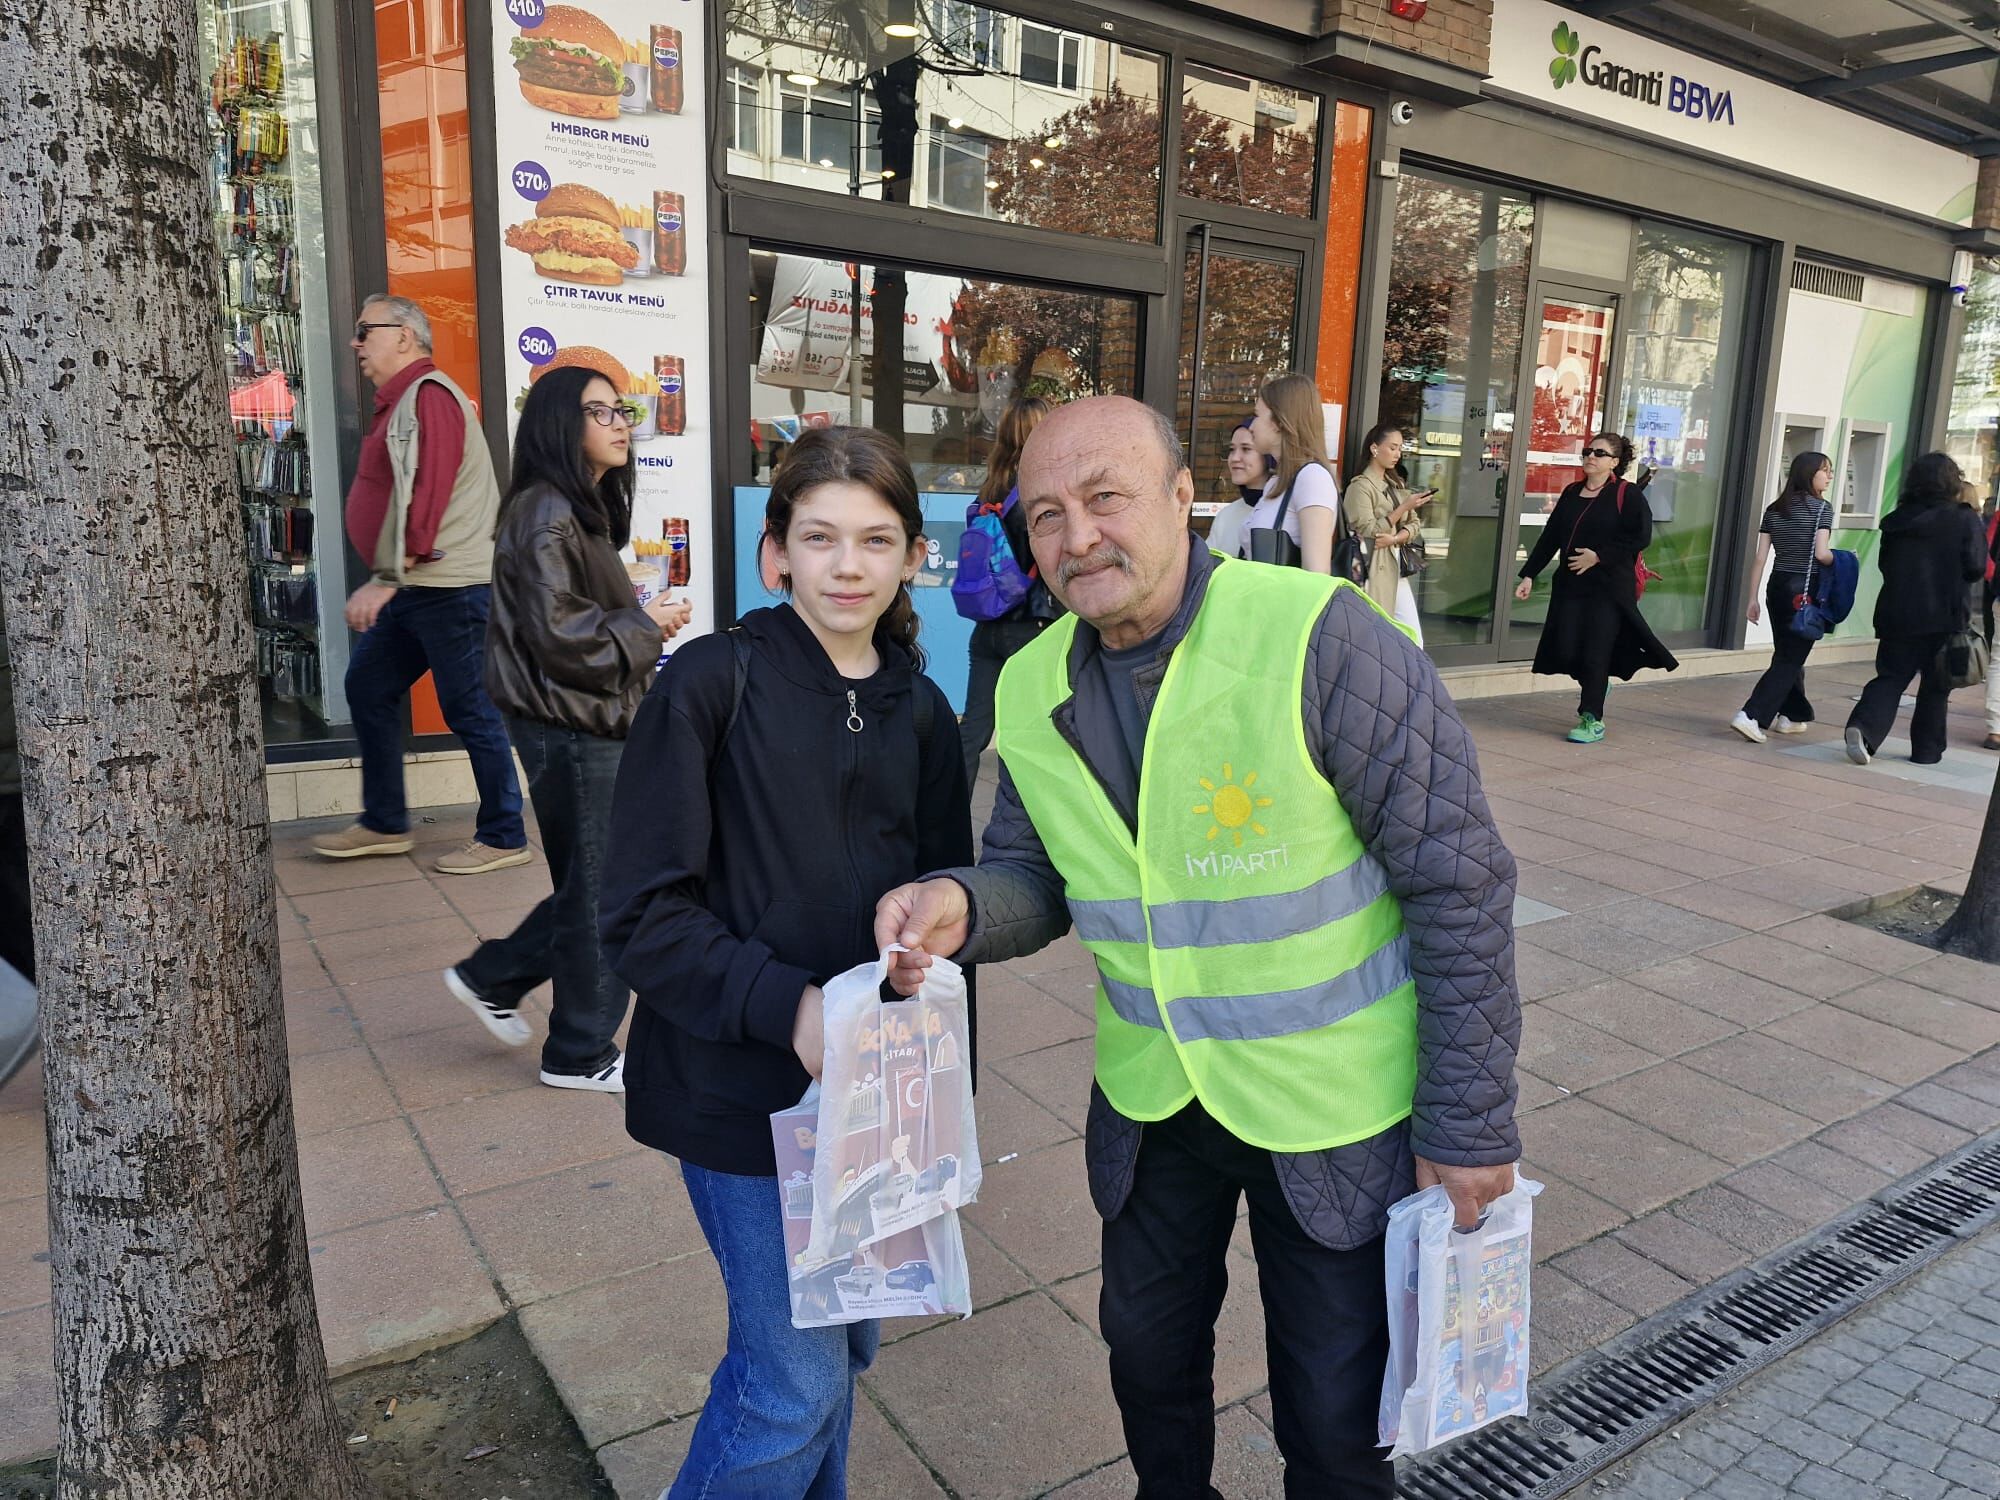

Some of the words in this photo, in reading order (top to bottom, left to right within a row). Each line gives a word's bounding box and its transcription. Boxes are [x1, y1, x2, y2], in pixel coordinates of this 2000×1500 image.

[654, 47, 678, 58] PEPSI
[1579, 45, 1664, 106] Garanti
[1668, 75, 1735, 125] BBVA
[551, 121, 609, 141] HMBRGR
[611, 131, 650, 148] MENÜ
[657, 212, 681, 222] PEPSI
[543, 285, 578, 298] ÇITIR
[581, 288, 624, 304] TAVUK
[628, 294, 665, 308] MENÜ
[637, 455, 673, 467] MENÜ
